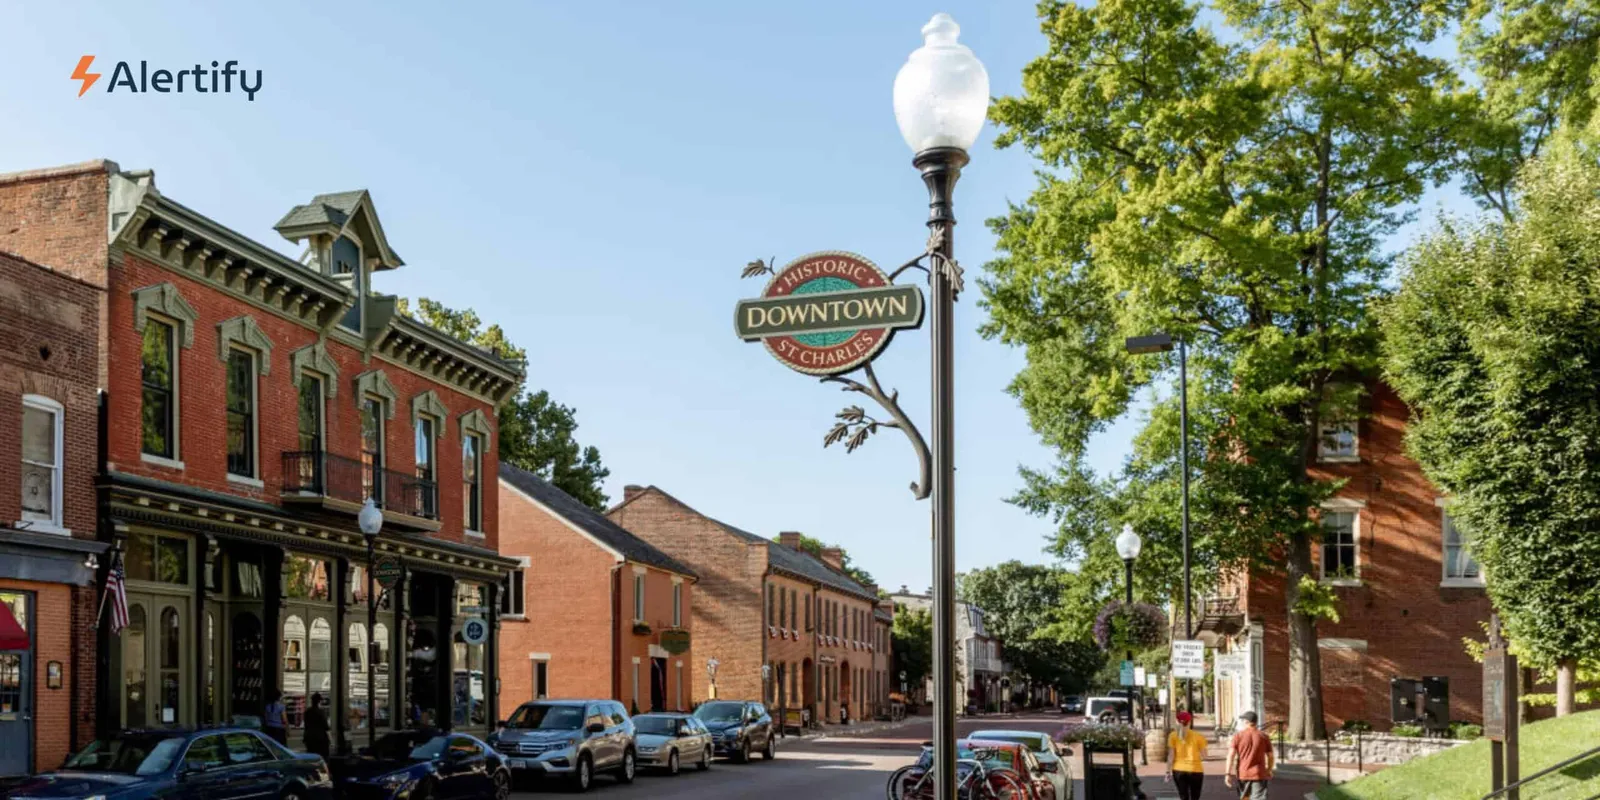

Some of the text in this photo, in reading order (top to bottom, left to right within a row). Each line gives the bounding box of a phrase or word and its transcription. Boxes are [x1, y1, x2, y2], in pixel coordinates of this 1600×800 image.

[783, 259, 867, 287] HISTORIC
[747, 295, 907, 329] DOWNTOWN
[800, 333, 874, 365] CHARLES
